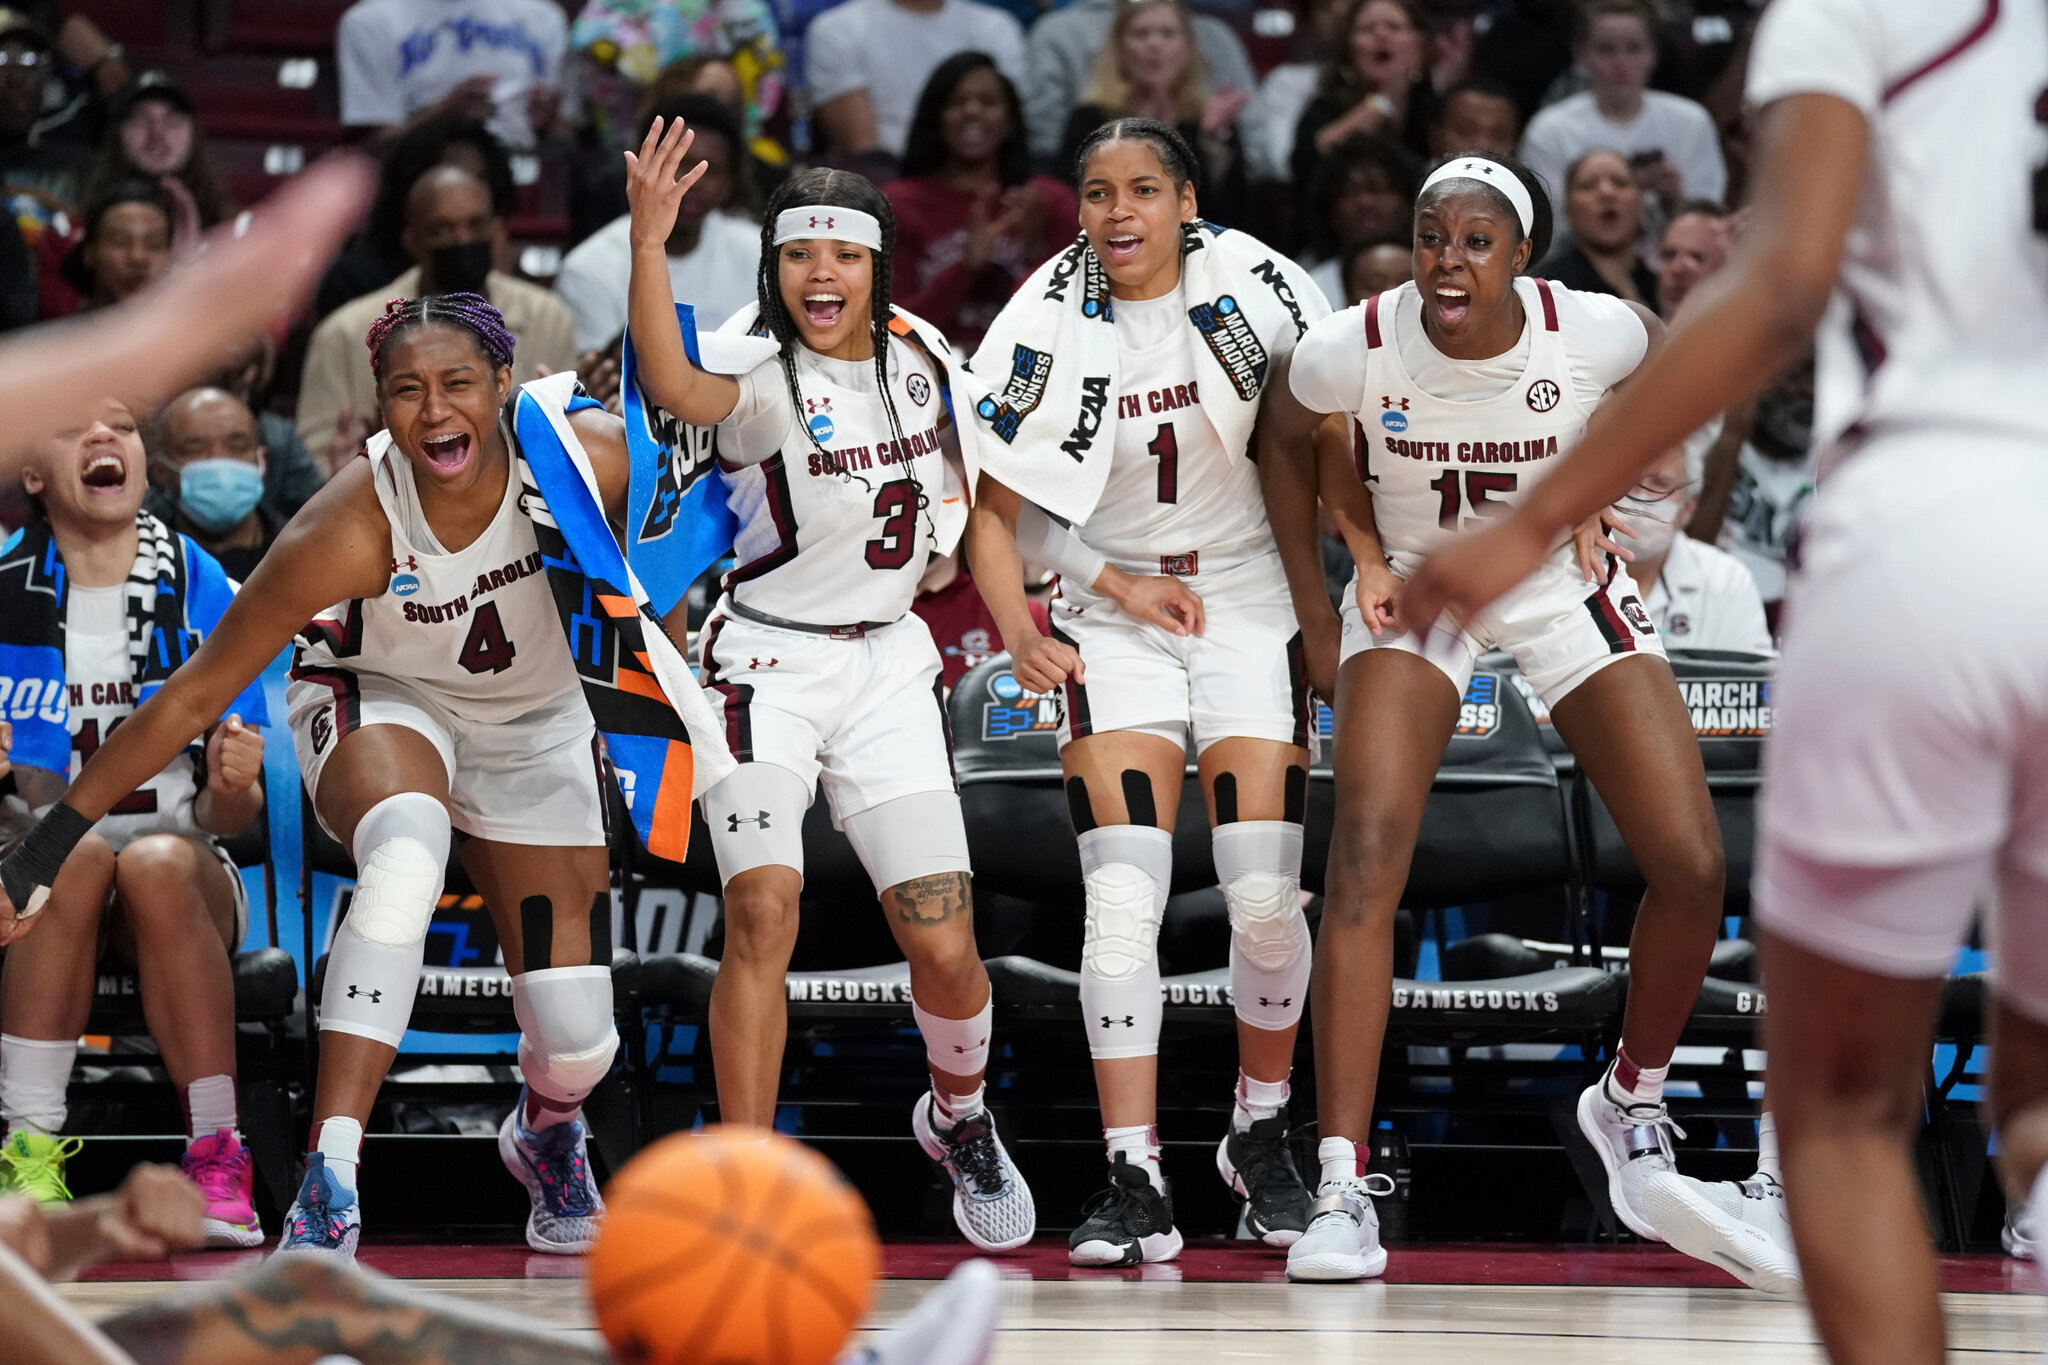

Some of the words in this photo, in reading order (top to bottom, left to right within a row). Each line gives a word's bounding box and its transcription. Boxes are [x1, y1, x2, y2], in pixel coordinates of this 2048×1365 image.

[1211, 330, 1259, 400] MADNESS
[1223, 312, 1266, 368] MARCH
[1060, 376, 1111, 464] NCAA
[1527, 380, 1560, 412] SEC
[808, 446, 873, 476] SOUTH
[1147, 422, 1178, 504] 1
[1385, 436, 1450, 462] SOUTH
[1457, 435, 1558, 463] CAROLINA
[864, 478, 920, 570] 3
[1430, 469, 1518, 533] 15
[395, 583, 419, 593] NCAA
[403, 595, 469, 624] SOUTH
[458, 600, 516, 675] 4
[1392, 988, 1560, 1013] GAMECOCKS
